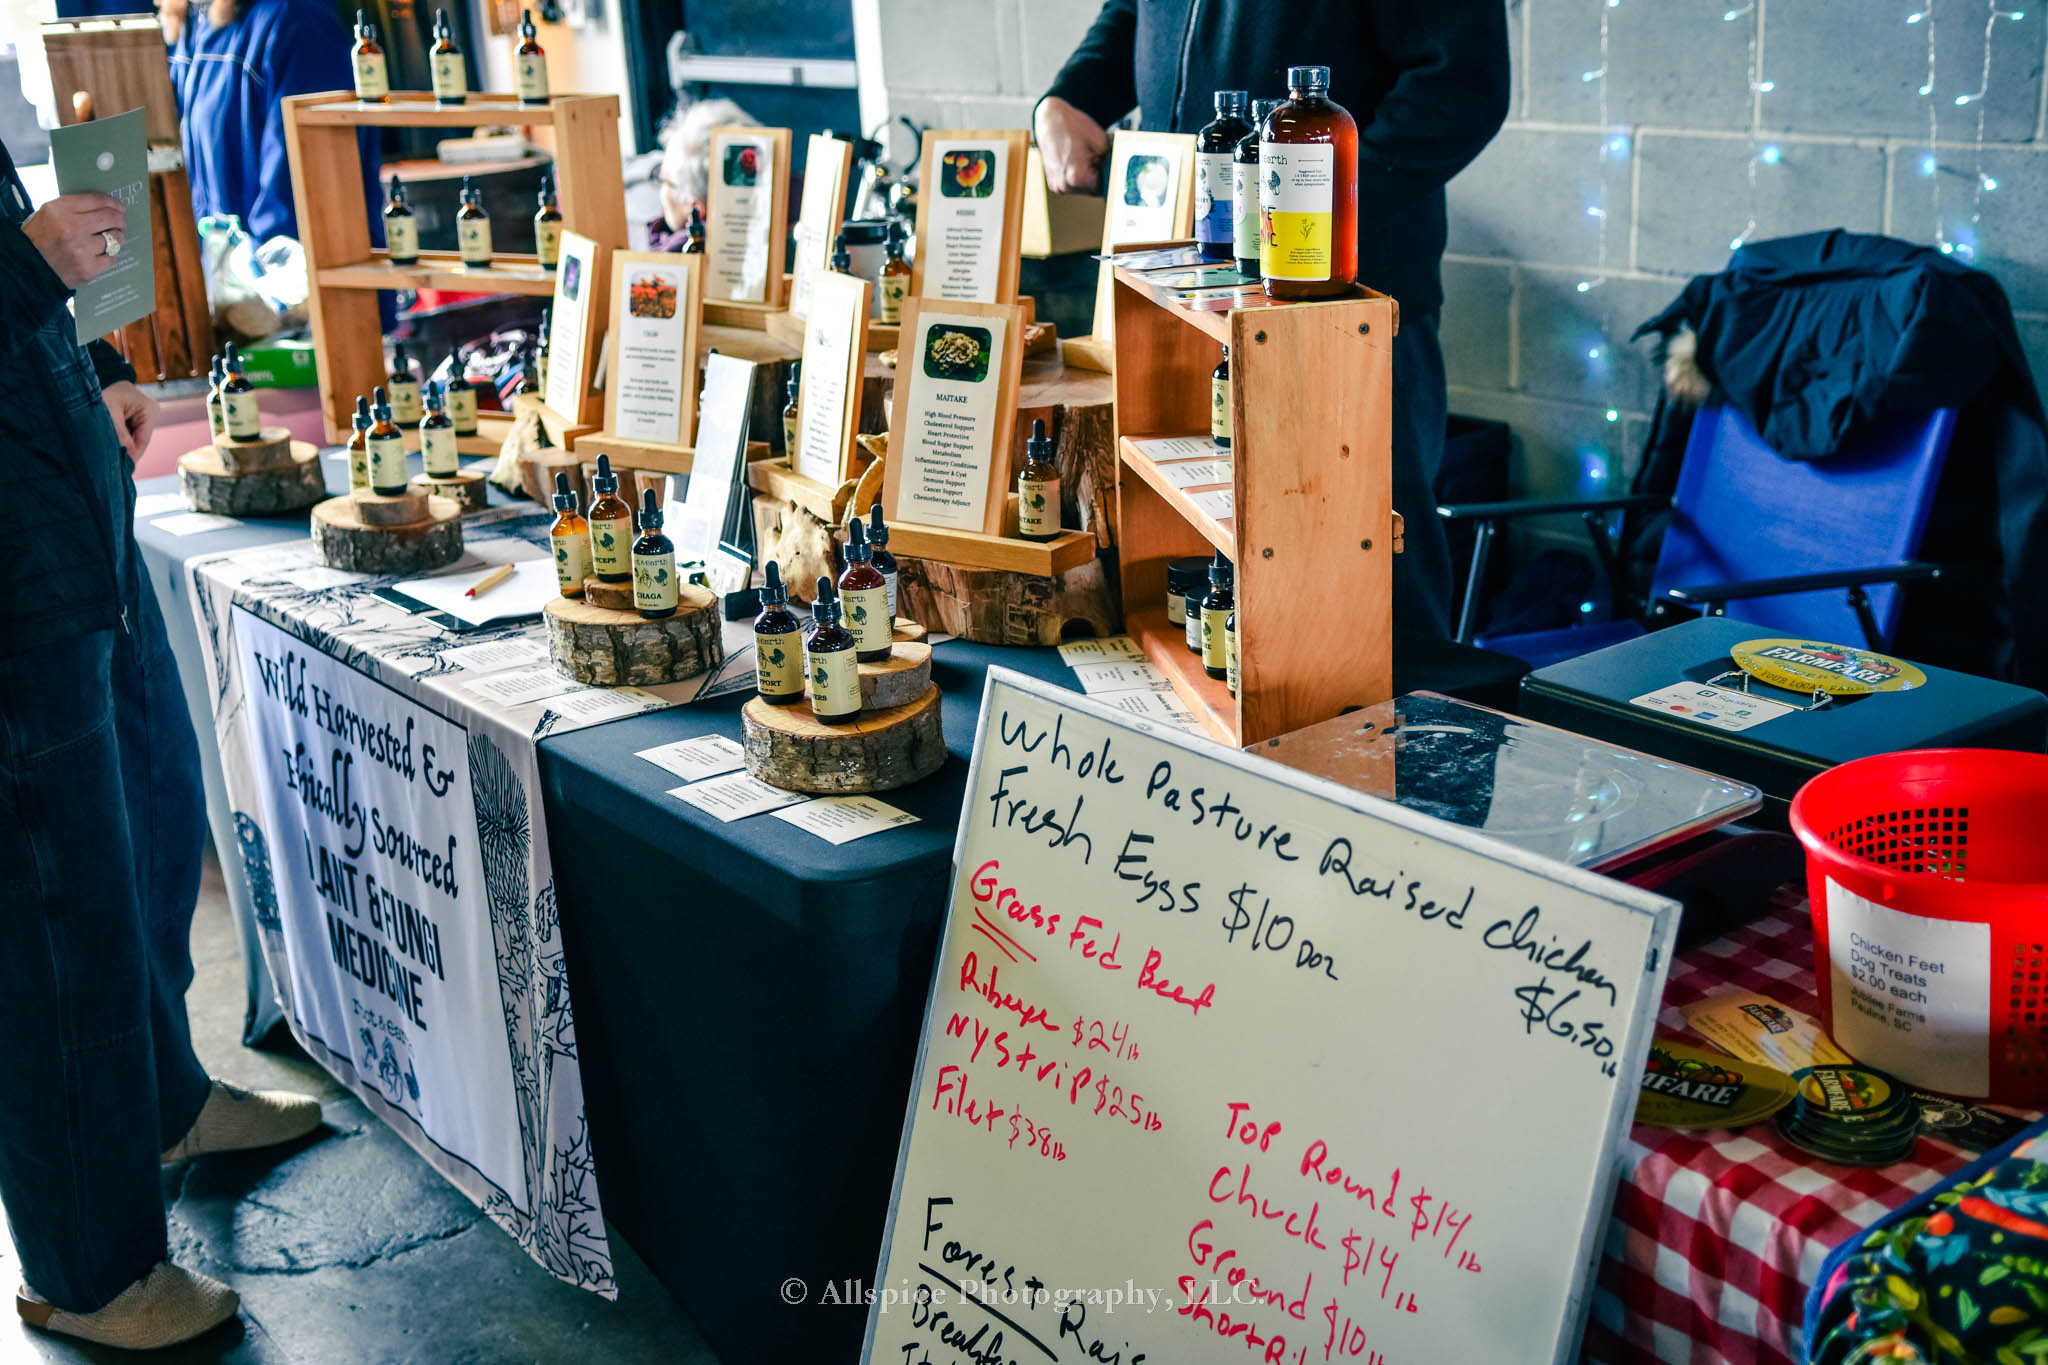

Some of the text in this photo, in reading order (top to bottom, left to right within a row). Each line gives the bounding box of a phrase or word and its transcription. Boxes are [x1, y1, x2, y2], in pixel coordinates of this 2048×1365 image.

[924, 410, 976, 422] High Blood Pressure
[936, 393, 968, 404] MAITAKE
[922, 438, 974, 450] Blood Sugar Support
[924, 420, 975, 432] Cholesterol Support
[943, 432, 970, 440] Protective
[914, 456, 978, 470] Inflammatory Conditions
[923, 468, 950, 476] Antitumor
[932, 449, 962, 458] Metabolism
[913, 494, 971, 507] Chemotherapy Adjunct
[923, 476, 966, 487] Immune Support
[942, 488, 964, 496] Support
[636, 592, 662, 600] CHAGA
[1761, 646, 1891, 684] FARMFARE
[1761, 669, 1786, 685] YOUR
[254, 651, 454, 798] Wild Harvested &
[372, 807, 459, 899] Sourced
[990, 766, 1092, 865] Fresh
[1114, 830, 1200, 913] Eggs
[1222, 882, 1294, 951] $10
[1147, 761, 1299, 861] Pasture
[1320, 838, 1475, 930] Raised
[366, 873, 384, 932] &
[381, 886, 446, 981] FUNGI
[970, 860, 1216, 1016] Grass Fed Beef
[326, 911, 428, 1032] MEDICINE
[1850, 932, 1945, 974] Chicken Feet
[1851, 948, 1928, 988] Dog Treats
[960, 951, 1060, 1032] Ribeye
[1851, 964, 1928, 1004] $2.00 each
[1888, 1003, 1926, 1025] Farms
[1894, 1018, 1913, 1032] SC
[932, 1065, 1004, 1132] Filet
[1300, 1139, 1400, 1218] Round
[1208, 1163, 1327, 1250] Chuck
[923, 1197, 1044, 1311] Forest
[1188, 1219, 1312, 1320] Ground
